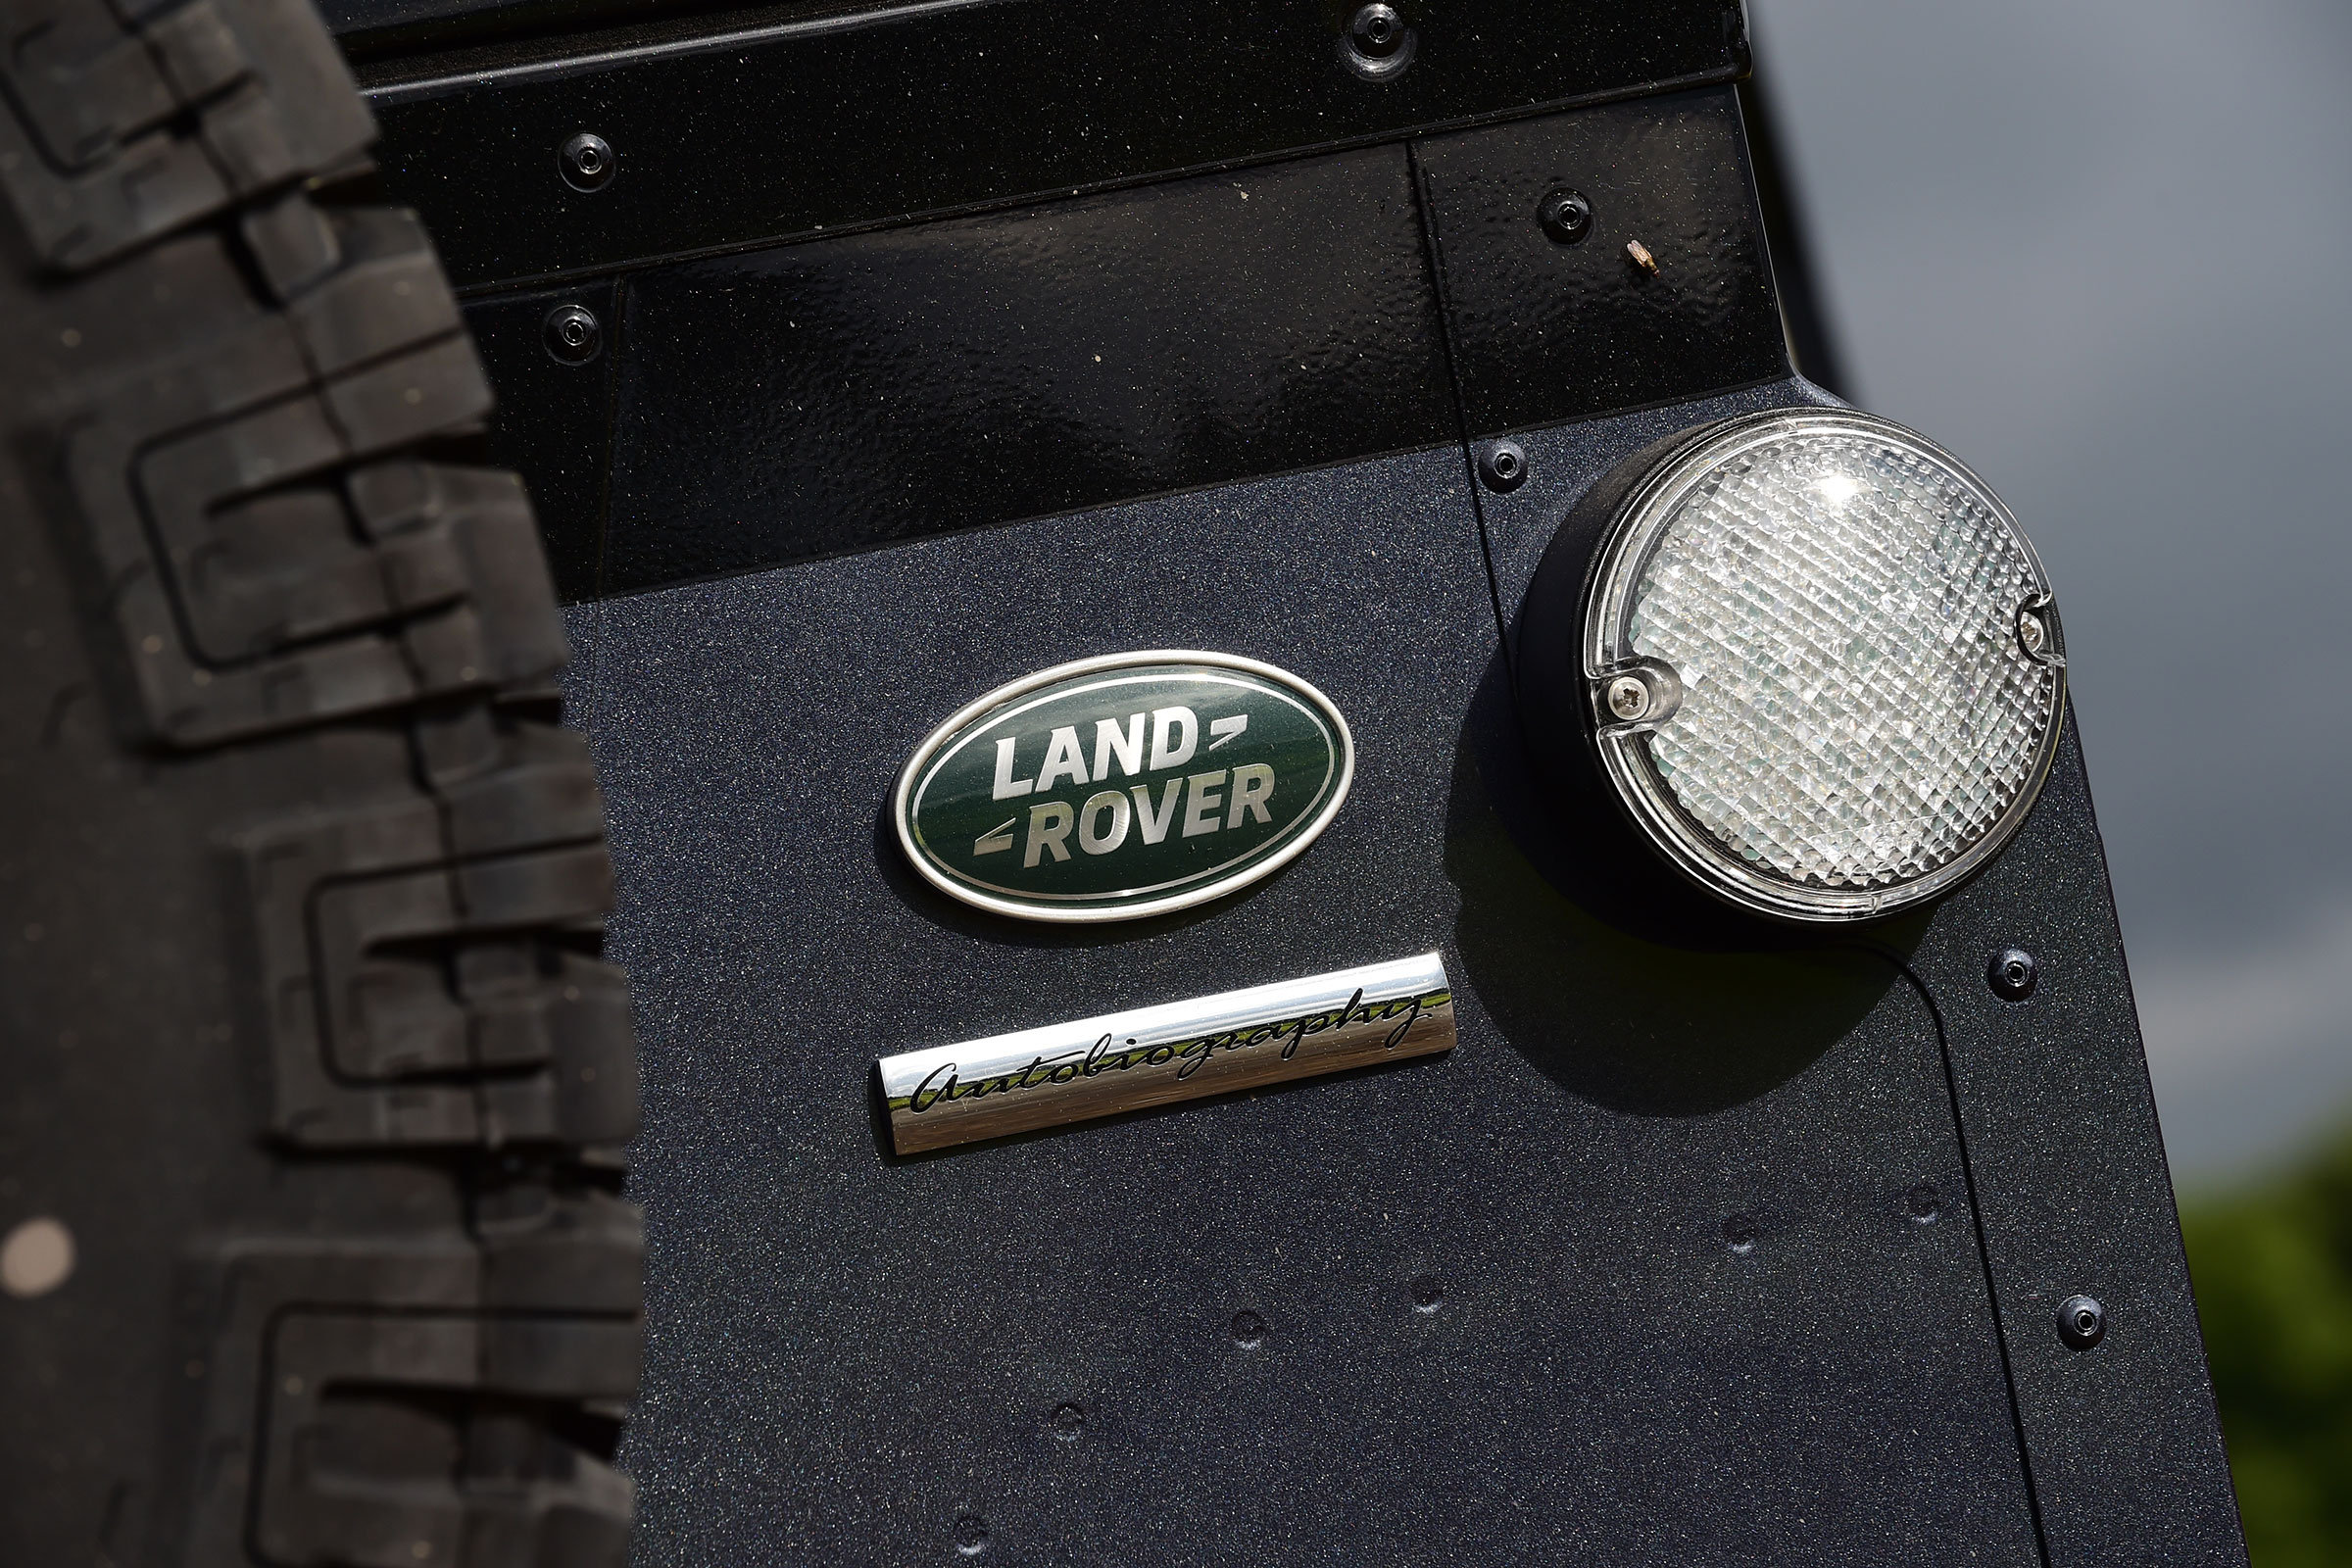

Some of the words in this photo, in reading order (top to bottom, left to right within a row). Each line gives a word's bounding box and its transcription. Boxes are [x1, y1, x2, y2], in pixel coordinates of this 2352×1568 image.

[992, 705, 1200, 800] LAND
[1023, 762, 1276, 869] ROVER
[909, 988, 1433, 1114] Autobiography
